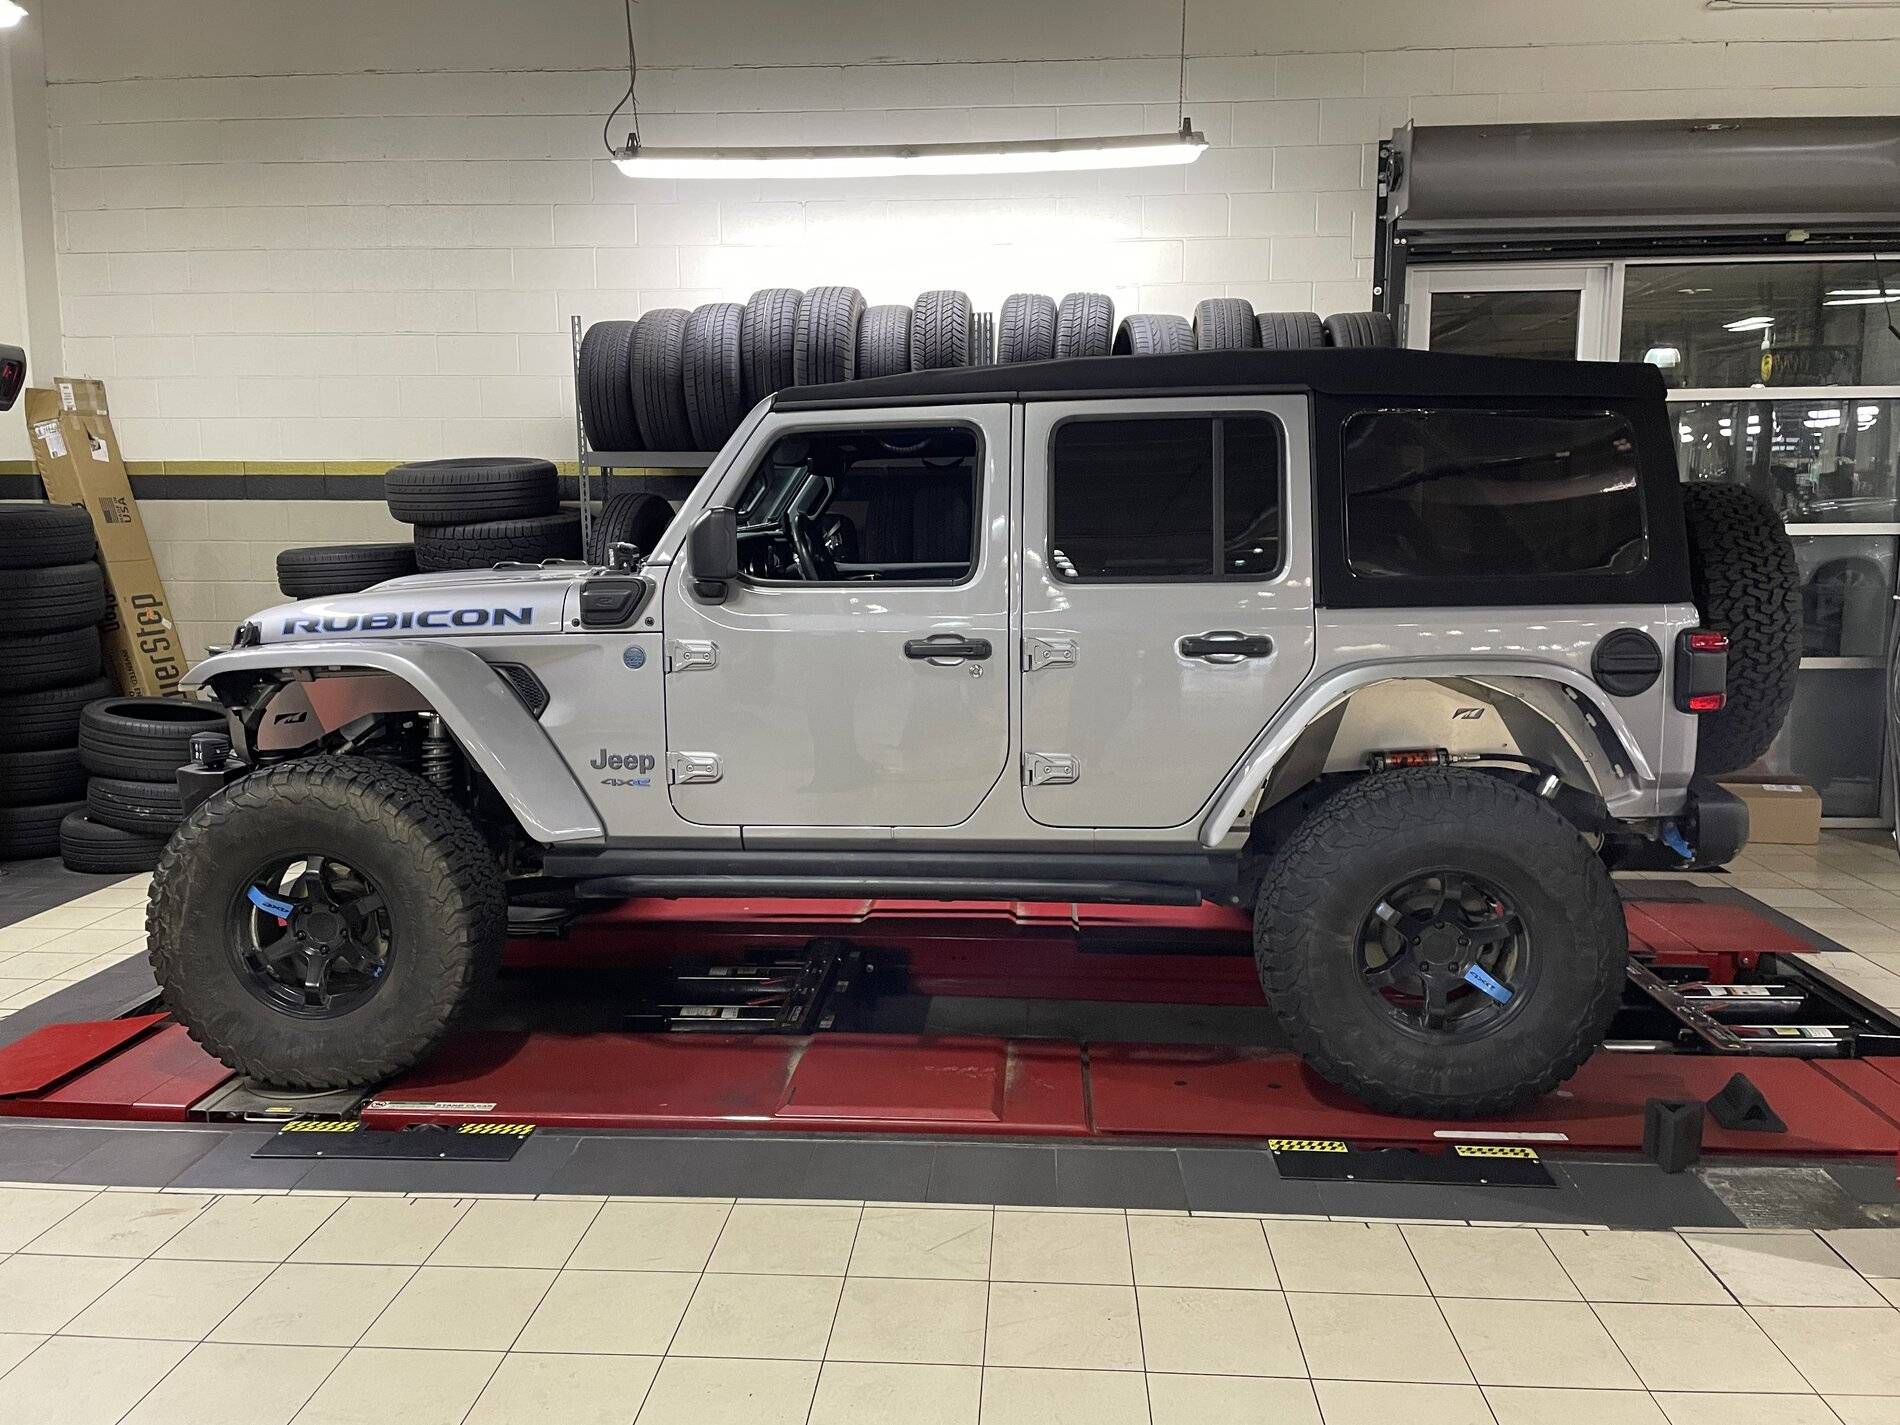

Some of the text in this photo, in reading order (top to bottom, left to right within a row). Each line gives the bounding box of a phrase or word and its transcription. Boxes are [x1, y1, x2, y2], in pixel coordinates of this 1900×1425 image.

[117, 496, 132, 523] USA
[281, 607, 534, 635] RUBICON
[589, 748, 655, 774] Jeep
